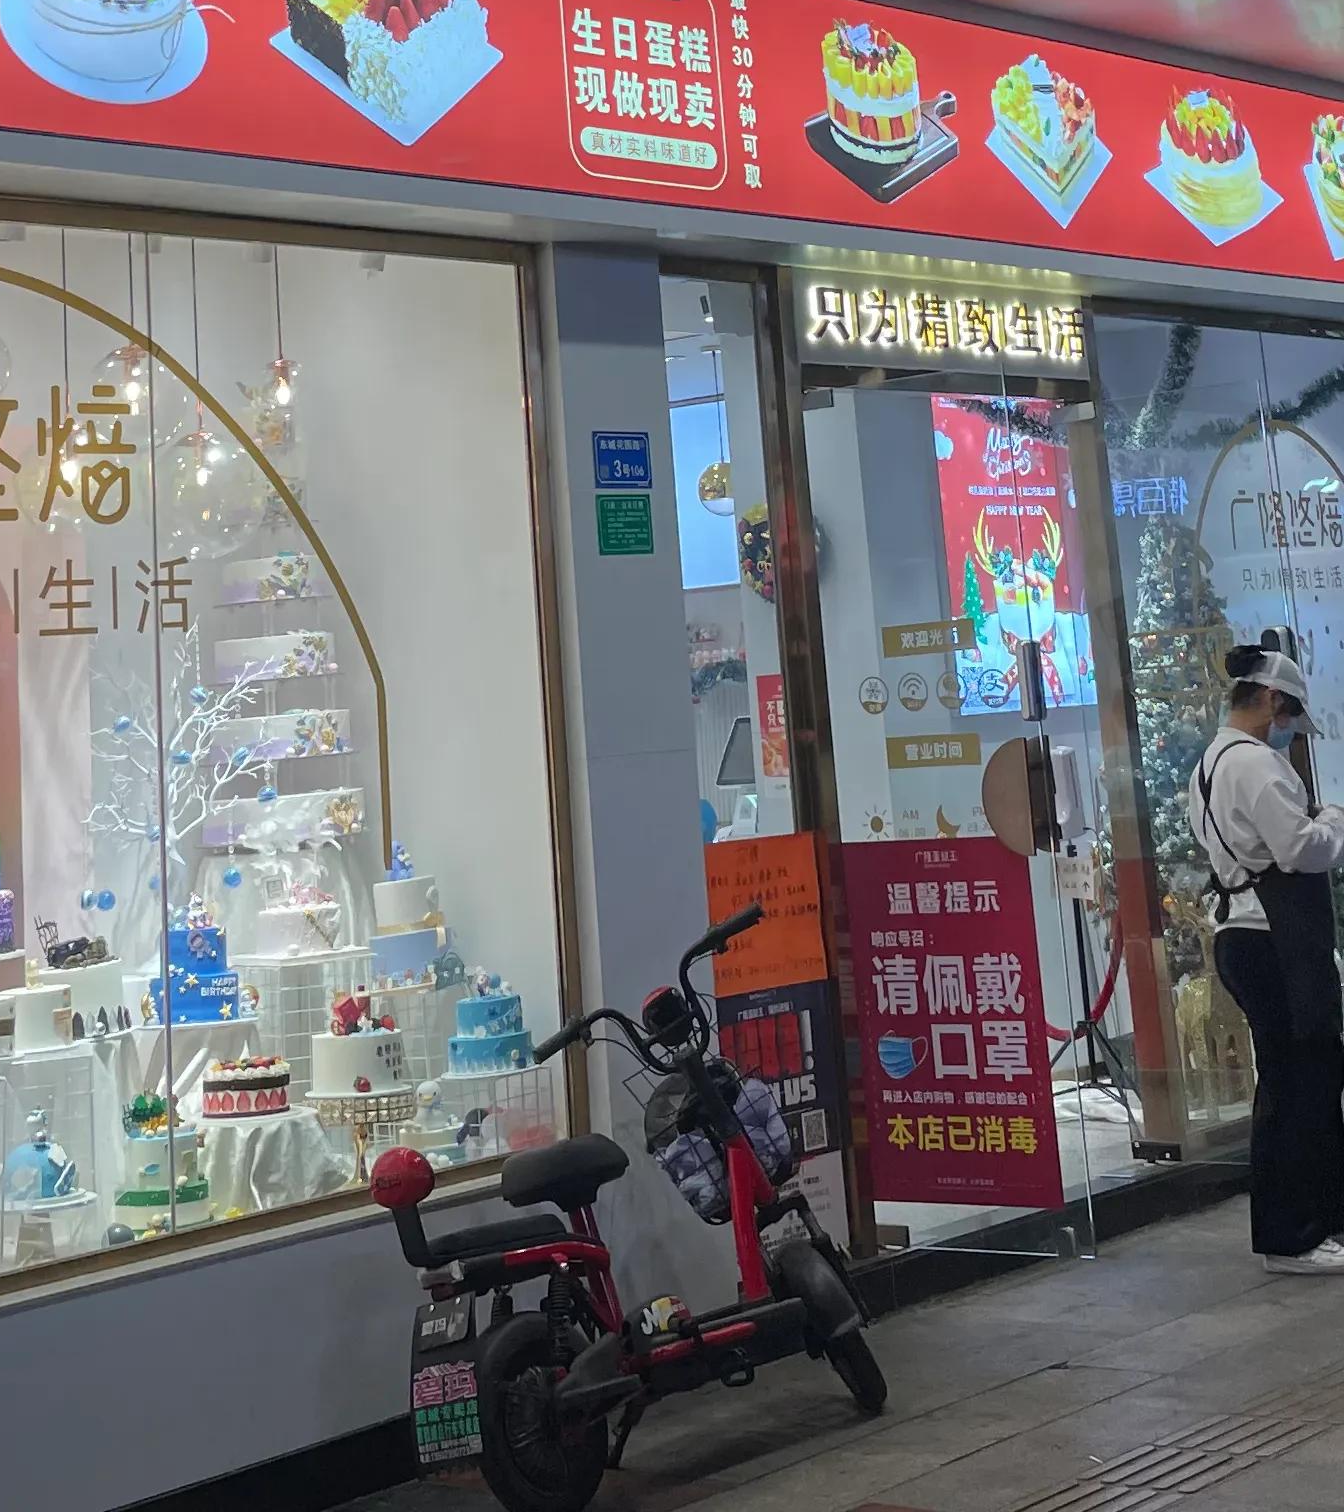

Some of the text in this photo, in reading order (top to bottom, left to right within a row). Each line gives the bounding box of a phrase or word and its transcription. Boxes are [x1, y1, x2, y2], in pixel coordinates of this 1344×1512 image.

[571, 8, 712, 74] 生日蛋糕
[573, 66, 716, 130] 现做现卖
[590, 131, 708, 165] 真材实料味道好
[905, 742, 963, 761] 营业时间
[887, 880, 1000, 915] 温馨提示
[872, 952, 1025, 1016] 请佩戴
[930, 1020, 1033, 1081] 口罩
[887, 1114, 1038, 1154] 本店已消毒
